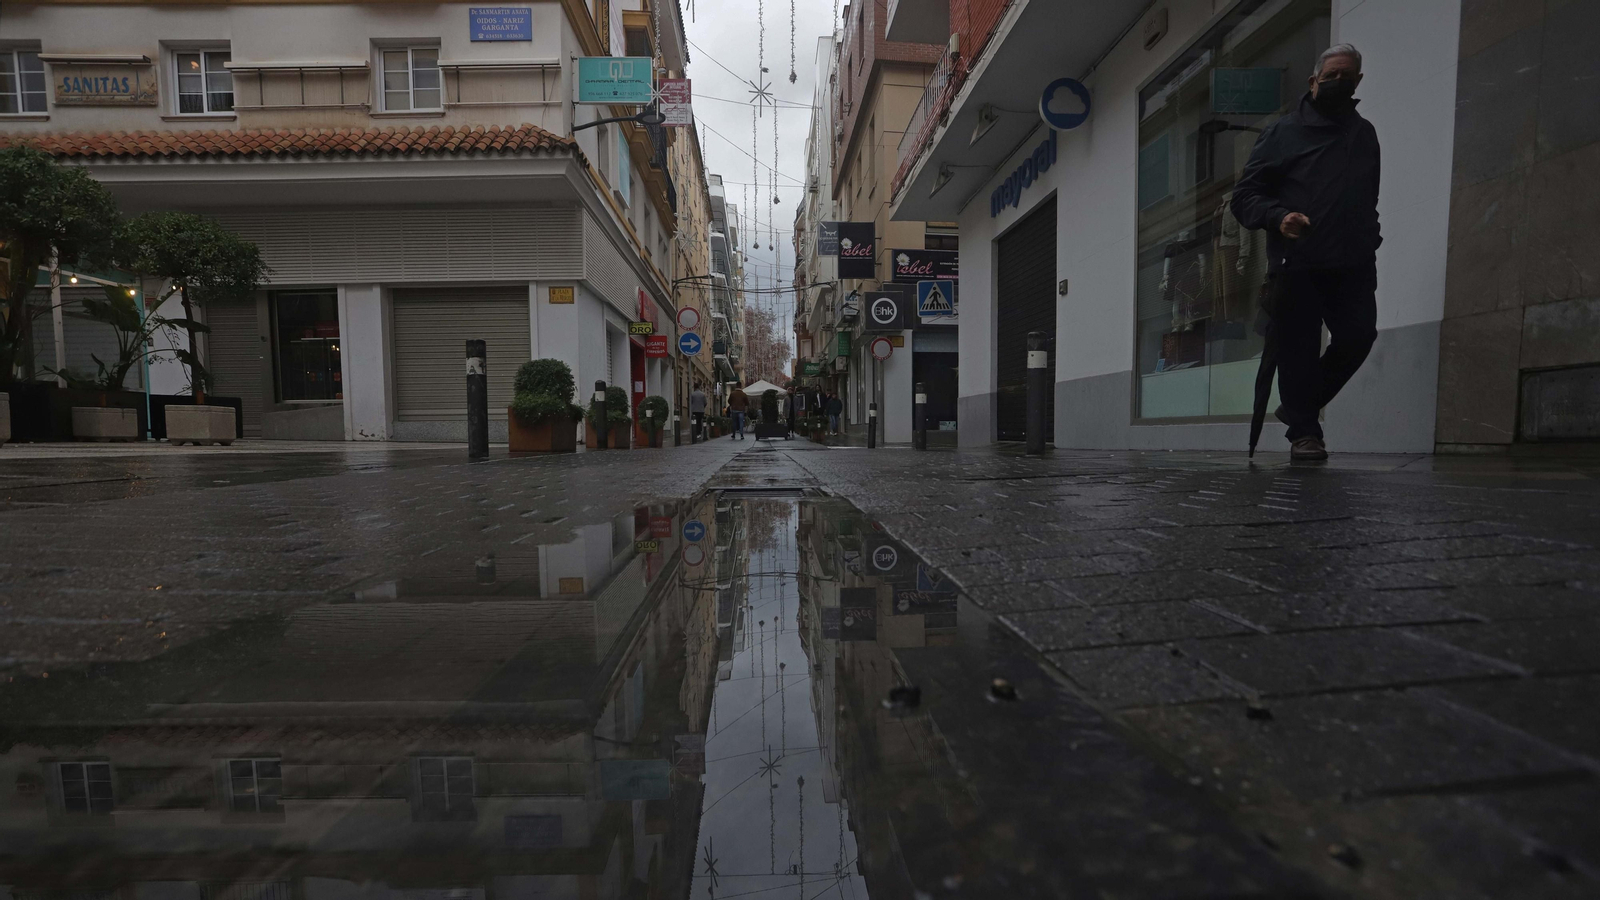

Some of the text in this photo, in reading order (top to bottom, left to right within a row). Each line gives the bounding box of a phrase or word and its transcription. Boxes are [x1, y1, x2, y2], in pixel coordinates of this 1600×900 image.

[63, 77, 130, 94] SANITAS
[991, 128, 1057, 218] mayoral
[875, 306, 894, 316] Bhk
